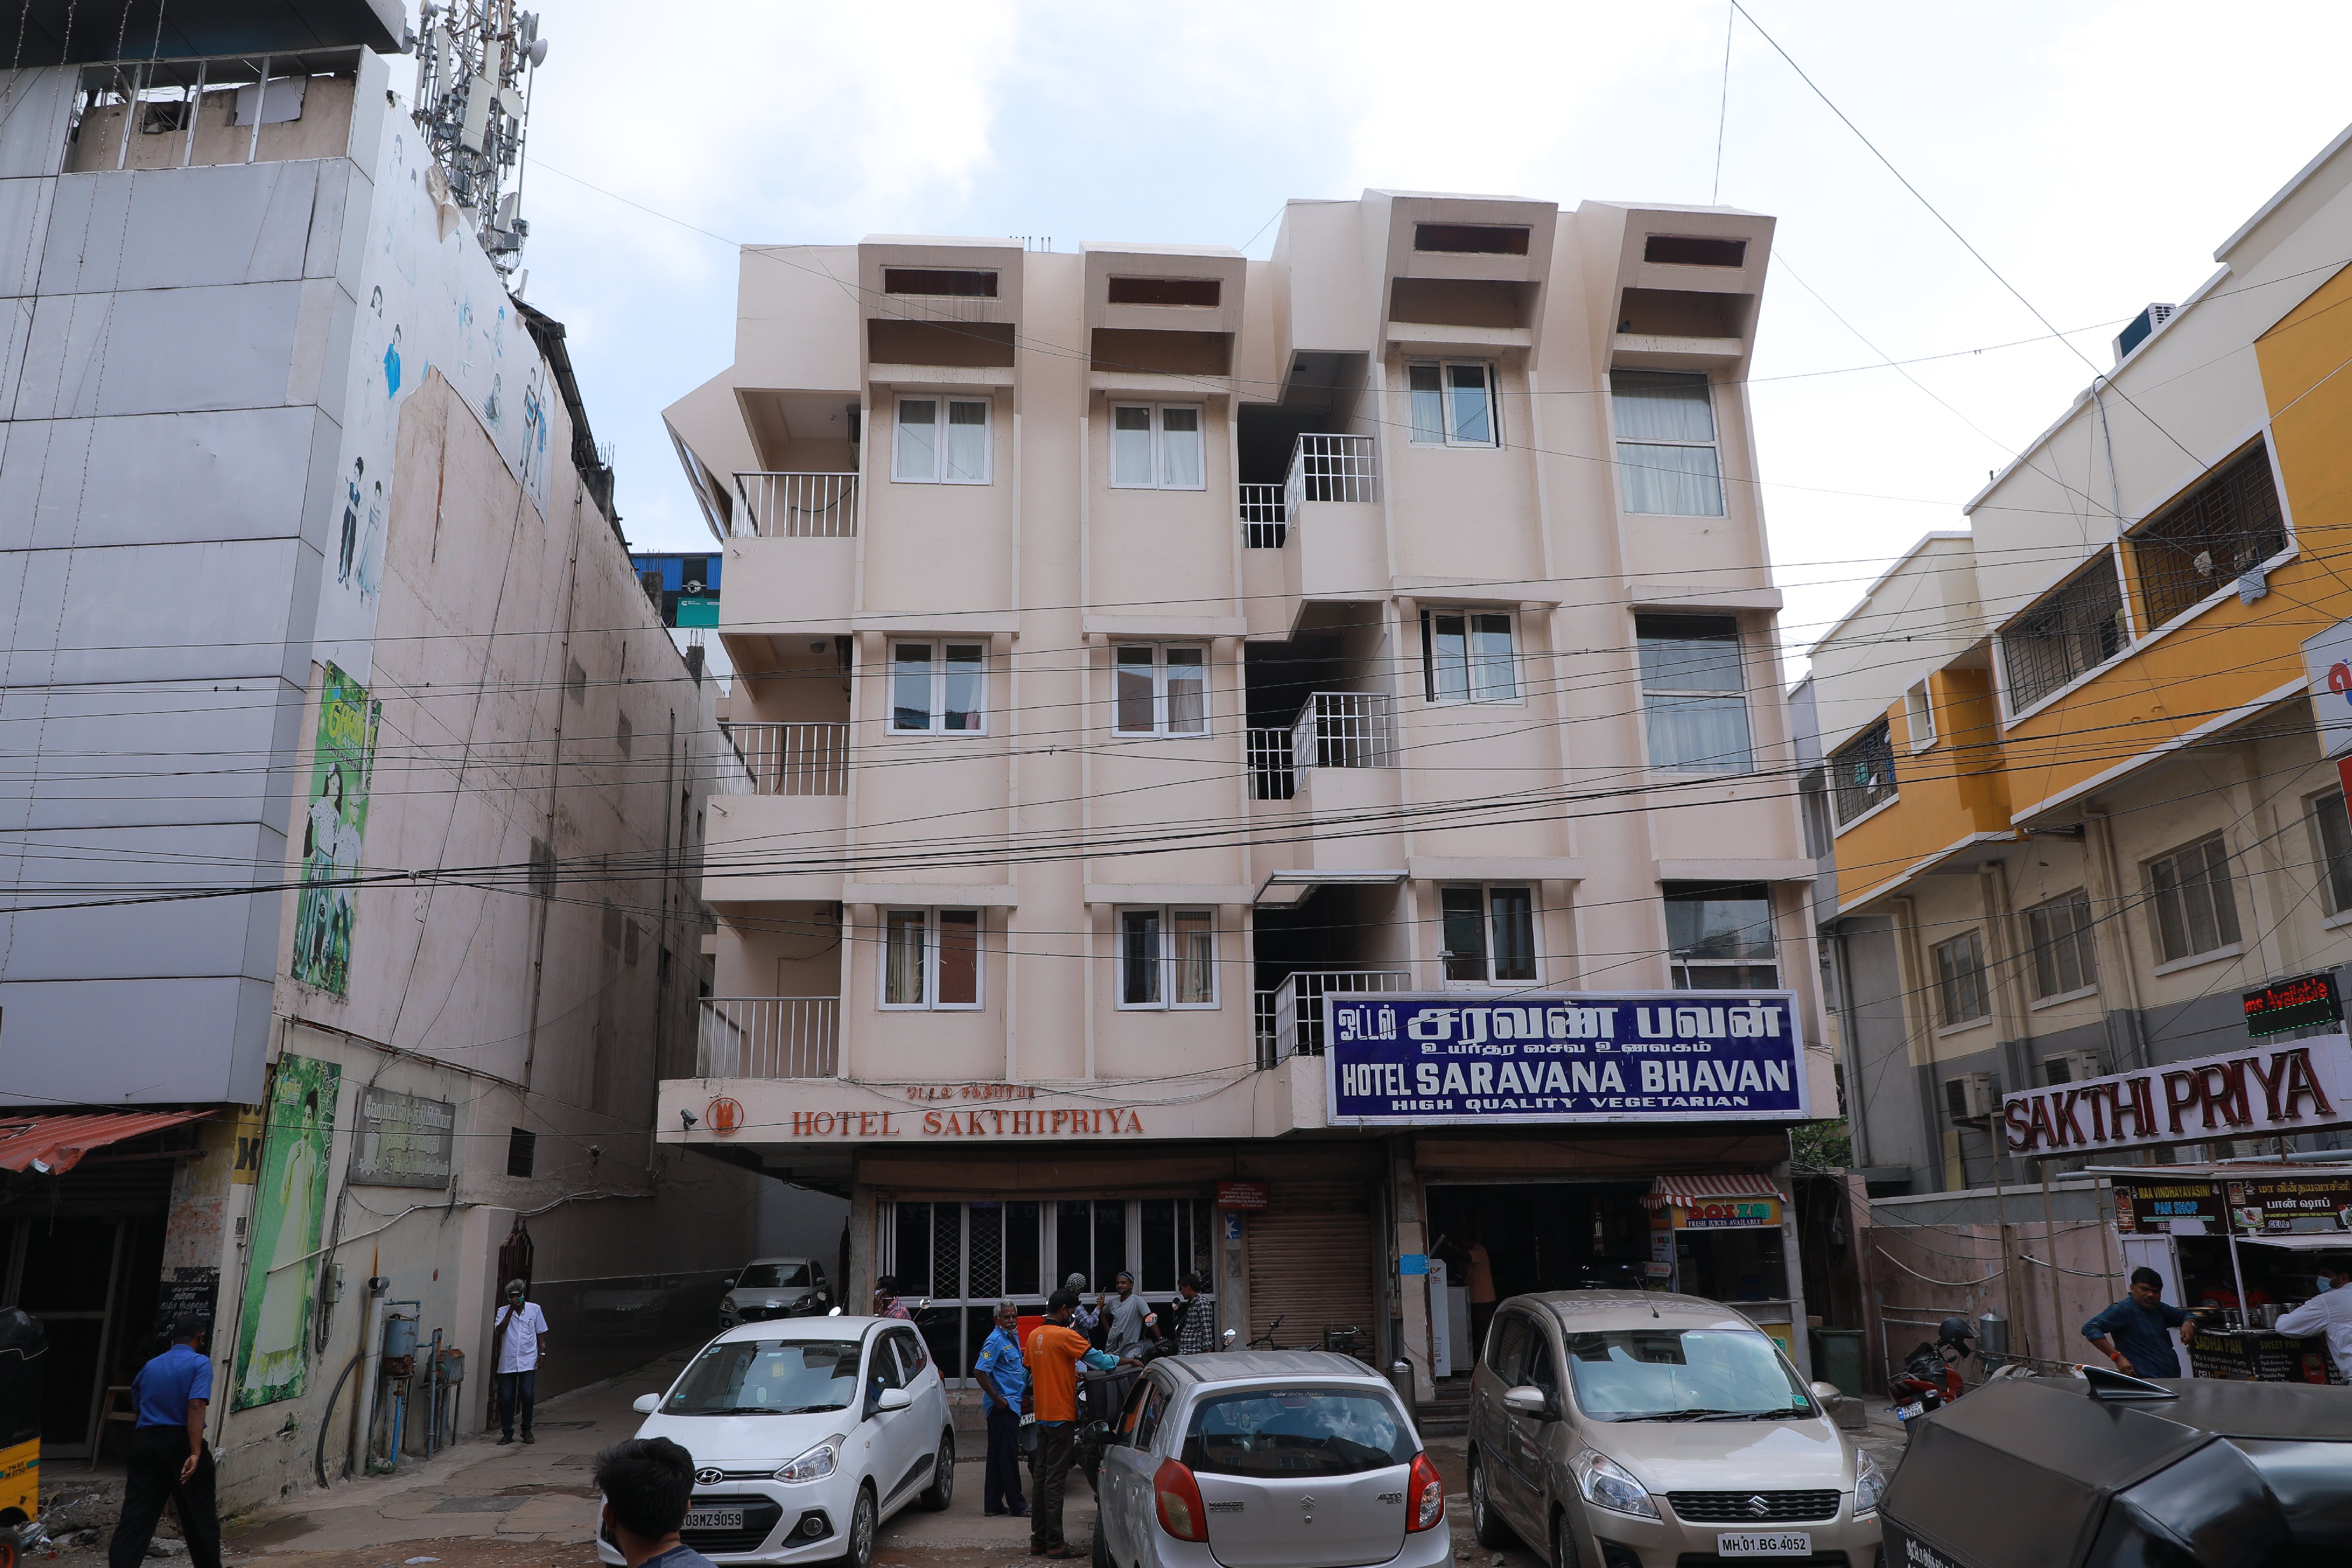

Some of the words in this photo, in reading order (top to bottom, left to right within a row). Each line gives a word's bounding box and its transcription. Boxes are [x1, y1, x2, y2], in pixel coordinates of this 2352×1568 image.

[1636, 1000, 1782, 1038] பவன்
[1421, 1042, 1517, 1056] உயர்தர
[1523, 1044, 1585, 1054] சைவ
[1595, 1040, 1712, 1054] உணவகம்
[1342, 1063, 1412, 1096] HOTEL
[1416, 1060, 1626, 1095] SARAVANA
[1640, 1060, 1790, 1092] BHAVAN
[1392, 1099, 1453, 1110] HIGH
[1466, 1098, 1578, 1113] QUALITY
[1589, 1096, 1748, 1108] VEGETARIAN
[2005, 1076, 2159, 1152] SAKTHI
[2160, 1048, 2336, 1132] PRIYA
[792, 1111, 900, 1135] HOTEL
[923, 1109, 1145, 1135] SAKTHIPRIYA
[384, 1156, 394, 1175] 25
[2138, 1187, 2153, 1199] MAA
[2153, 1184, 2211, 1198] VINDHAYAVASINI
[2257, 1185, 2274, 1194] மா
[2153, 1202, 2173, 1214] PAN
[2173, 1201, 2198, 1214] SHOP
[2266, 1198, 2297, 1209] பான்
[2299, 1196, 2331, 1210] ஷாப்
[2268, 1220, 2290, 1228] CELL:
[2194, 1335, 2224, 1352] SADHA
[2224, 1338, 2243, 1355] PAN
[2259, 1340, 2283, 1350] SWEET
[2284, 1339, 2301, 1349] PAN
[2193, 1360, 2210, 1368] Orders
[2227, 1366, 2252, 1376] Functions
[1375, 1491, 1402, 1502] ALTO
